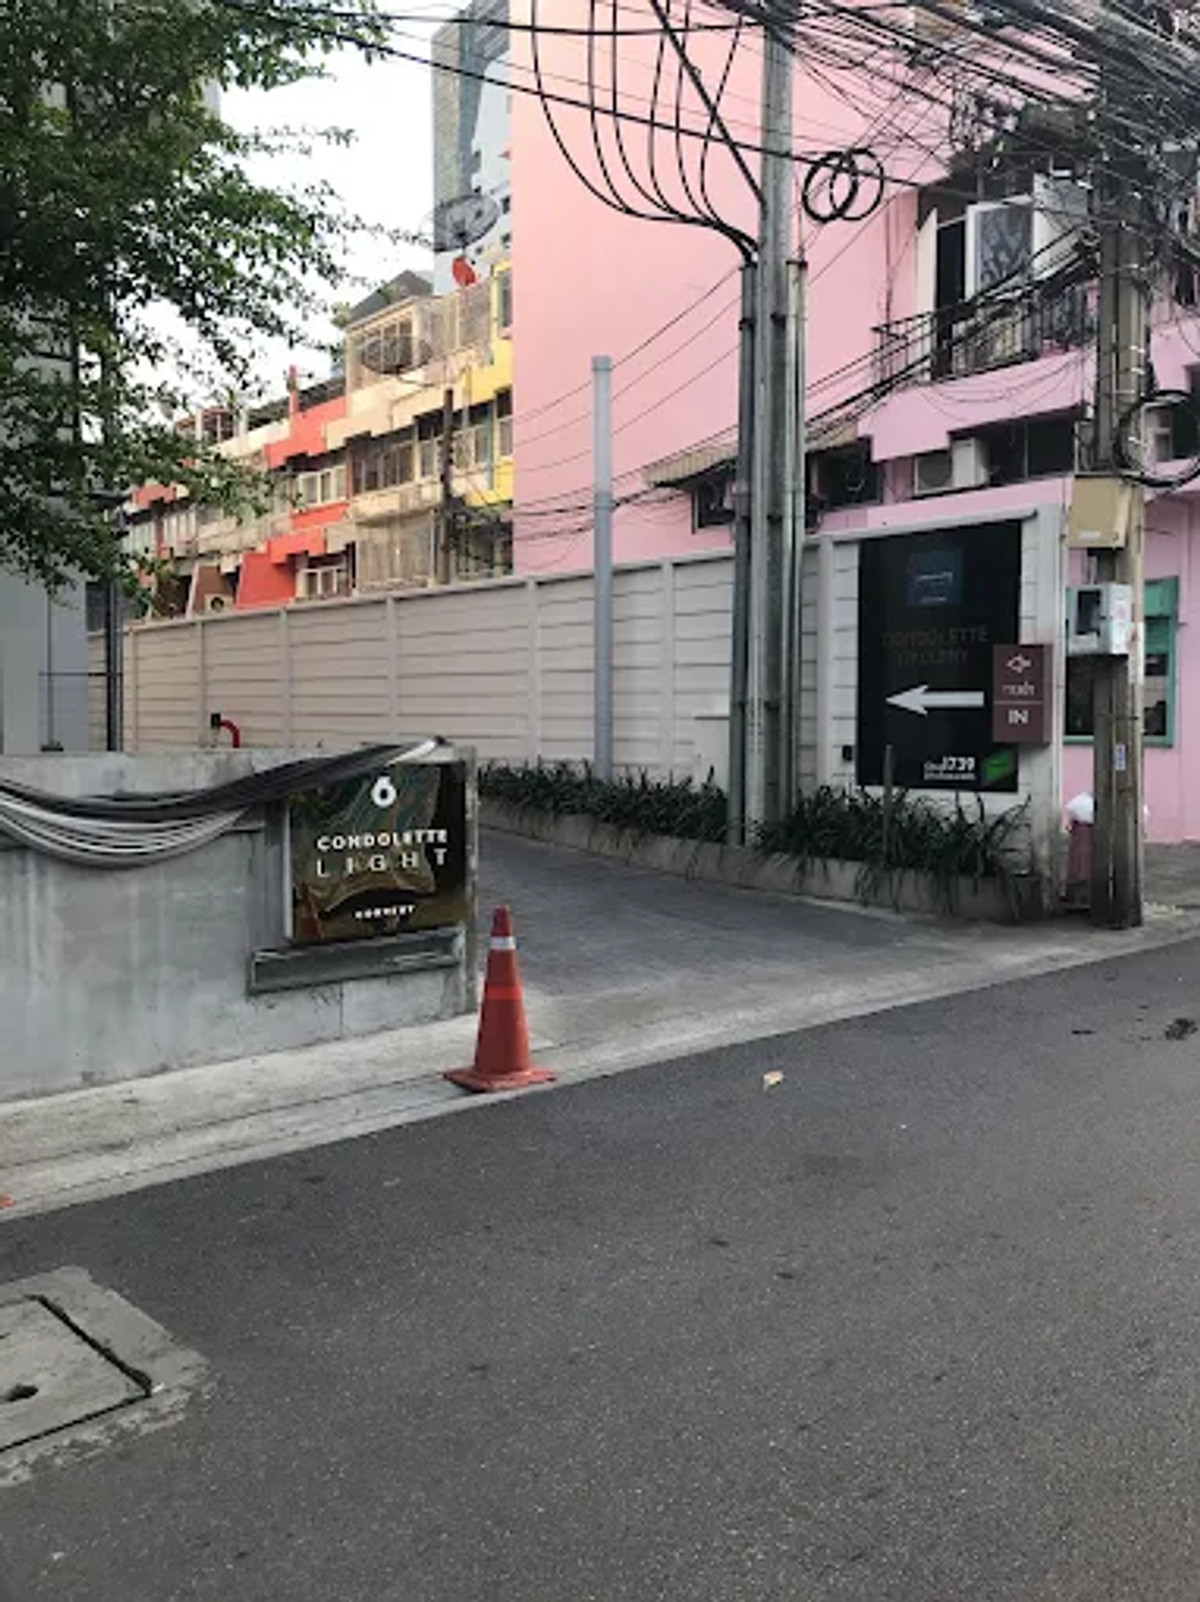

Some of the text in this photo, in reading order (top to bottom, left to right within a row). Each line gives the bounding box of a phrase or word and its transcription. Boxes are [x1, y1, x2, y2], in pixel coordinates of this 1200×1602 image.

[1007, 709, 1029, 724] IN
[371, 776, 397, 807] 6
[316, 828, 448, 851] CONDOLETTE
[316, 847, 448, 878] LIGHT
